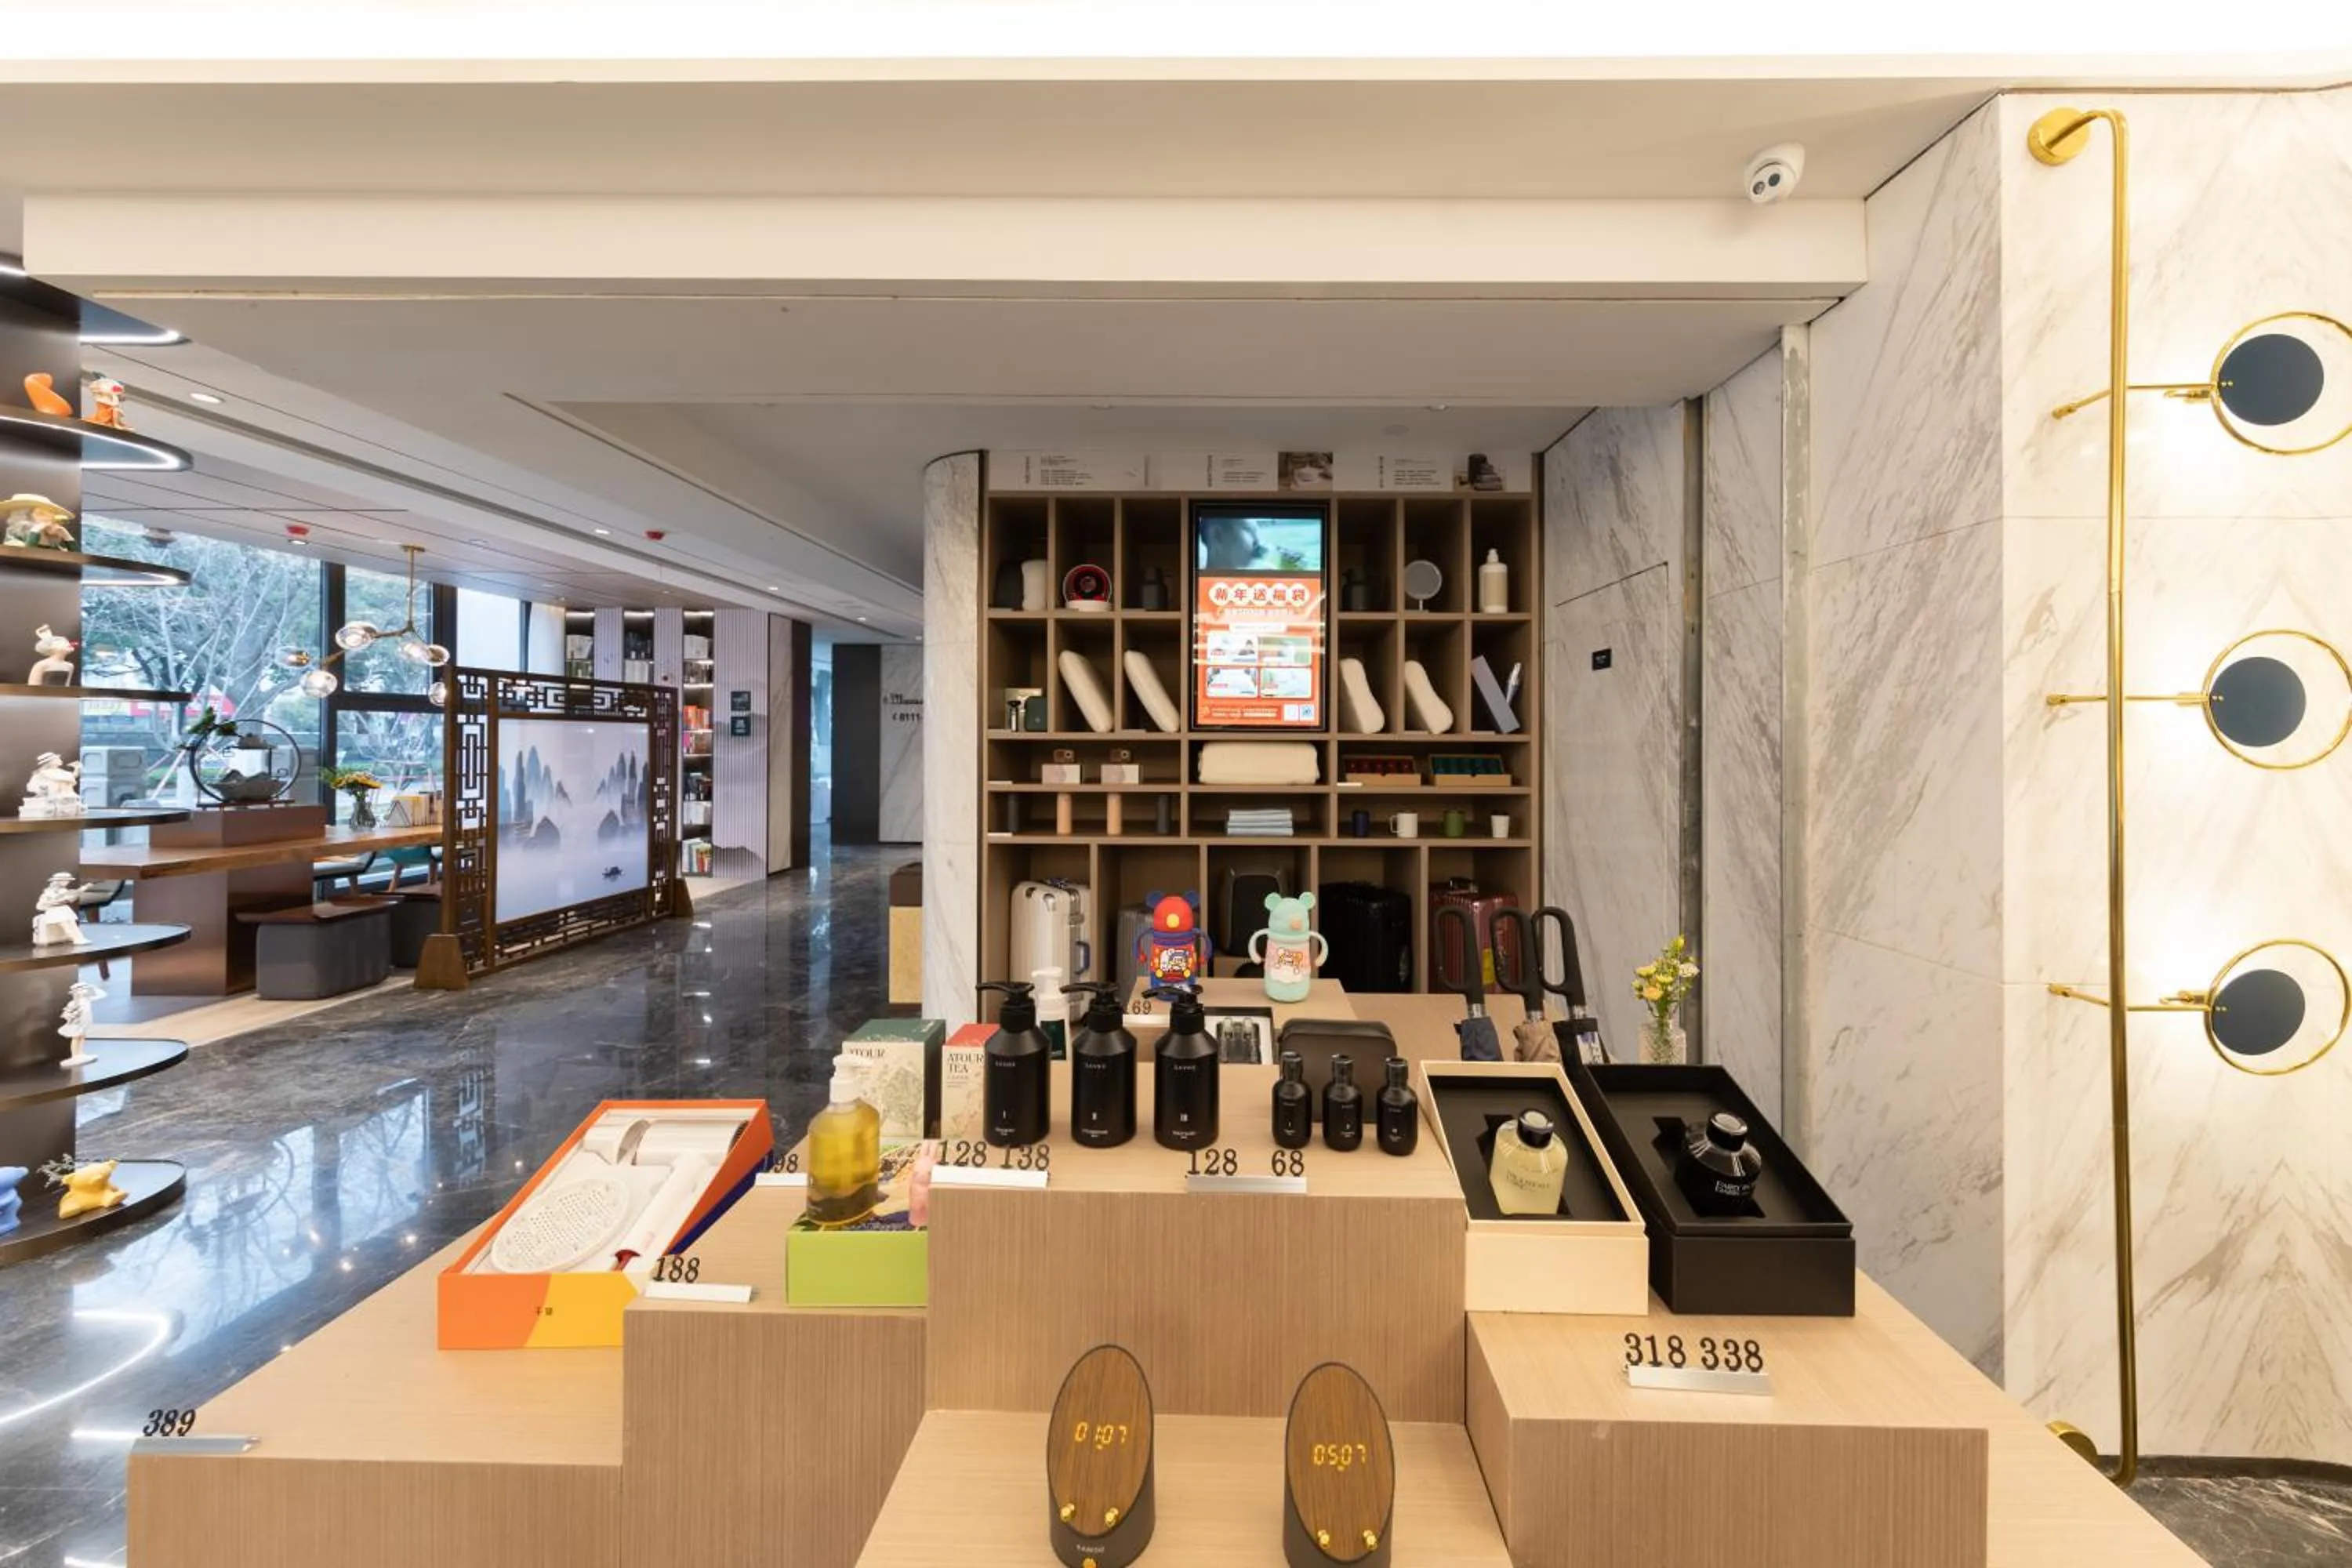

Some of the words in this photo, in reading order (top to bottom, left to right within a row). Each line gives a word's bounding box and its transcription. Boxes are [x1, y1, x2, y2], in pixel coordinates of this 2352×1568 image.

[947, 1053, 985, 1063] ATOUR
[949, 1063, 968, 1073] TEA
[936, 1139, 987, 1167] 128
[1000, 1144, 1050, 1171] 138
[1187, 1148, 1238, 1176] 128
[1271, 1149, 1305, 1177] 68
[652, 1257, 700, 1283] 188
[1624, 1332, 1686, 1368] 318
[1699, 1336, 1763, 1373] 338
[143, 1409, 196, 1436] 389
